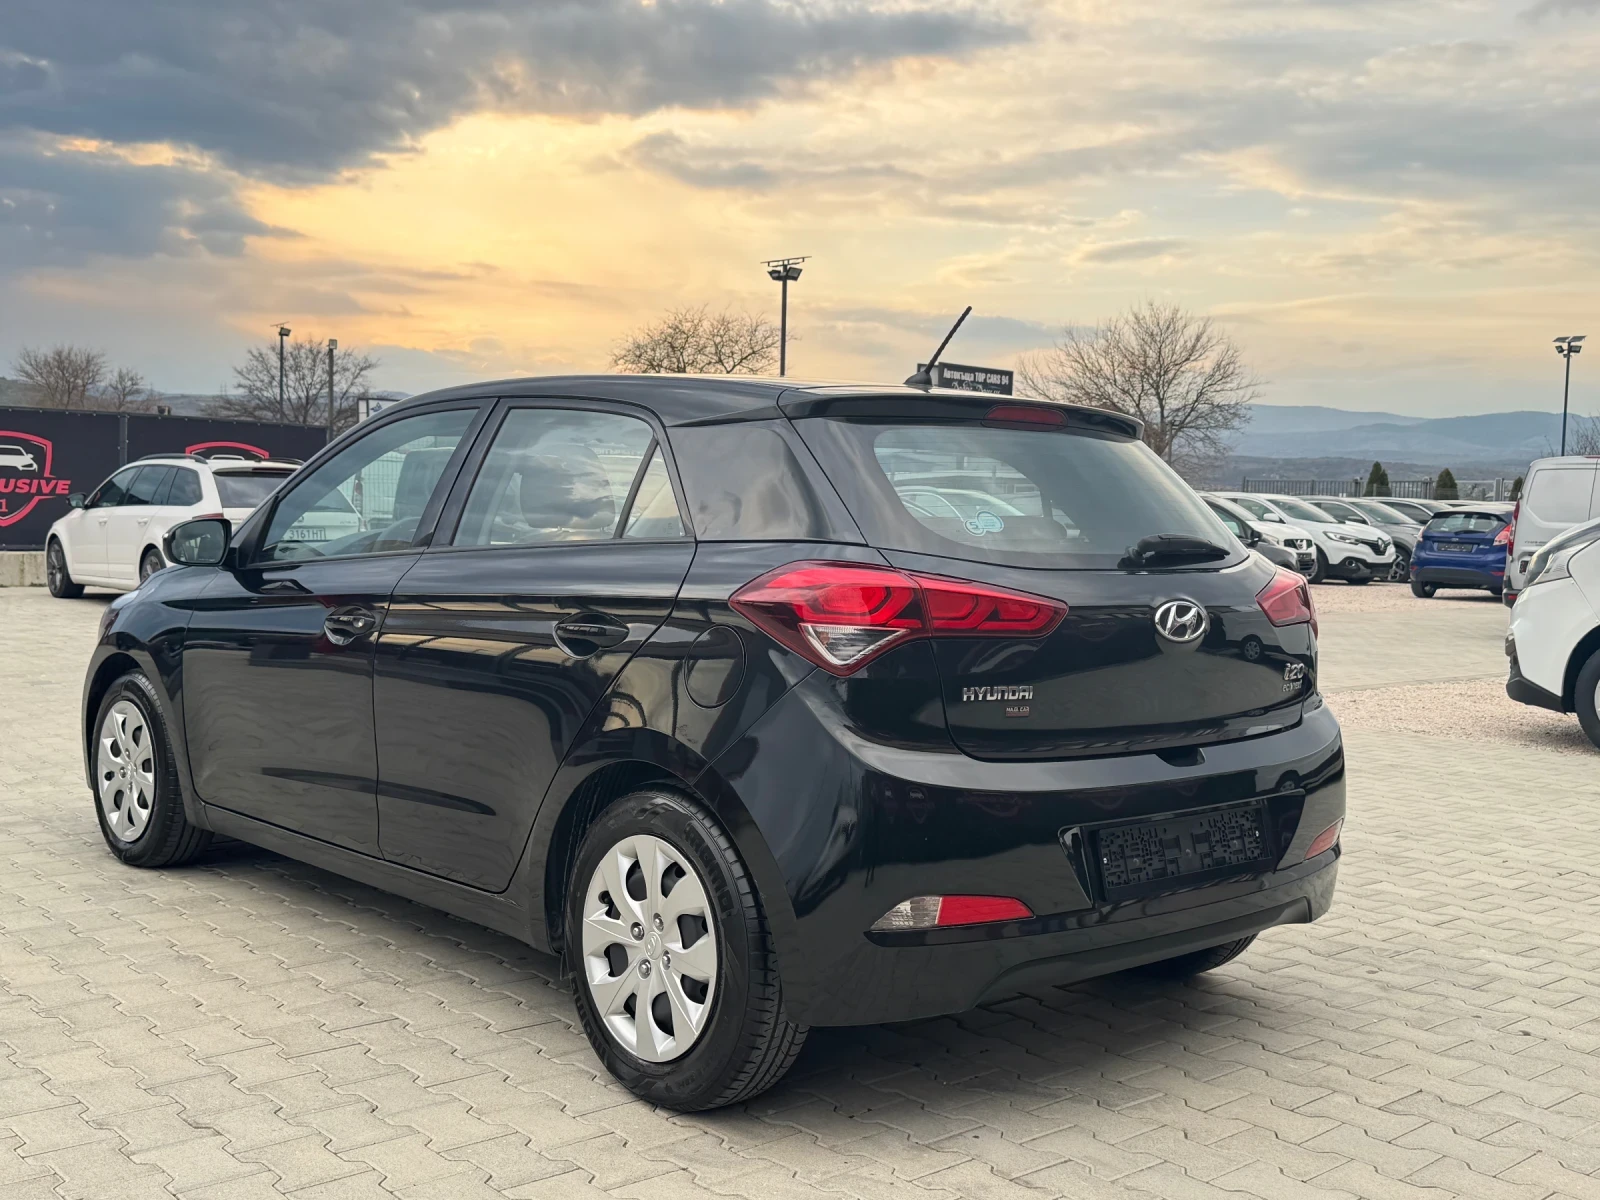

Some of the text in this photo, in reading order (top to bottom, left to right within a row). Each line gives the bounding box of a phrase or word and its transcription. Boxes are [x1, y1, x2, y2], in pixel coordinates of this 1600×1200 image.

[943, 368, 975, 382] Автокъща
[975, 371, 986, 382] TOP
[986, 373, 1001, 385] CARS
[1283, 662, 1305, 681] i20
[963, 685, 1034, 701] HYUNDAI
